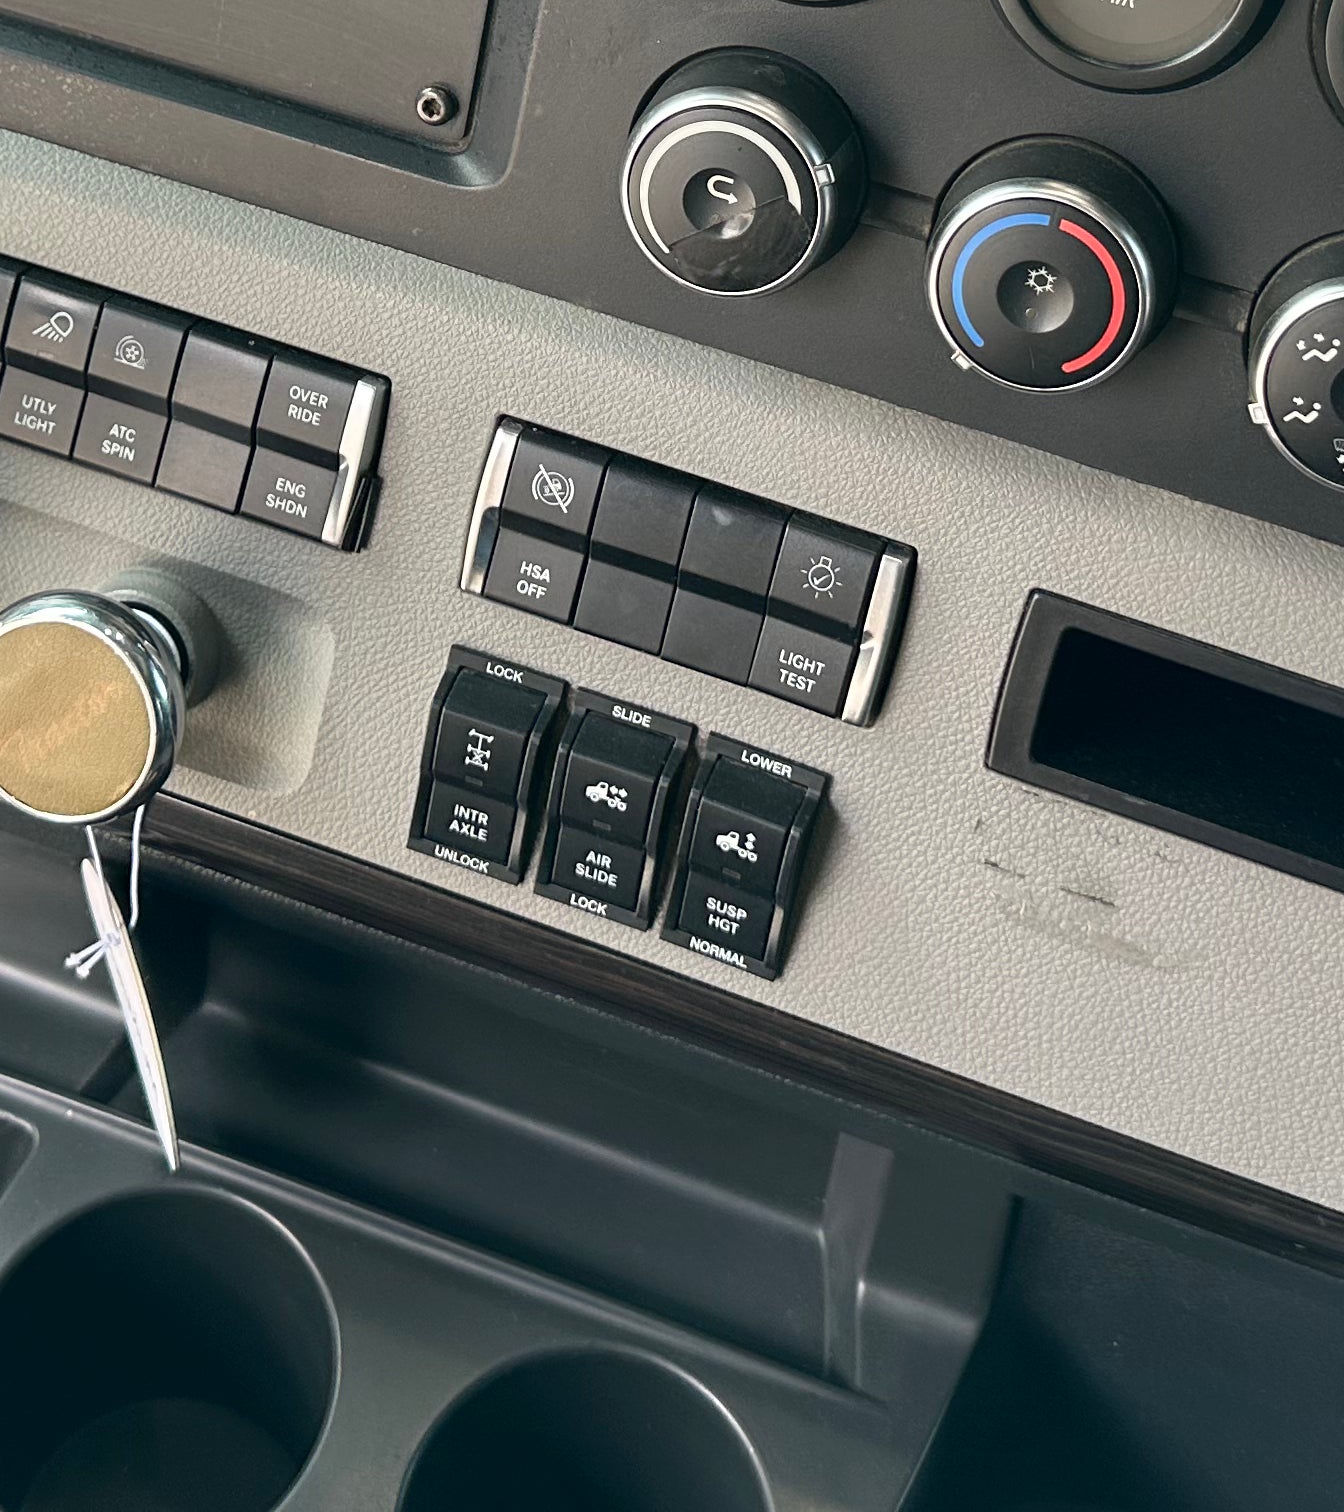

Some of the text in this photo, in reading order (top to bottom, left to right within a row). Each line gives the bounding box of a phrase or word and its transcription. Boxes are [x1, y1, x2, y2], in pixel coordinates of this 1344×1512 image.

[22, 394, 57, 415] UTLY
[289, 385, 329, 409] OVER
[14, 414, 56, 435] LIGHT
[287, 404, 321, 427] RIDE
[109, 423, 136, 443] ATC
[101, 440, 136, 463] SPIN
[275, 477, 306, 498] ENG
[265, 493, 308, 519] SHDN
[520, 560, 551, 584] HSA
[516, 579, 548, 600] OFF
[485, 661, 524, 684] LOCK
[778, 649, 826, 677] LIGHT
[779, 669, 816, 694] TEST
[612, 704, 652, 728] SLIDE
[740, 749, 793, 779] LOWER
[453, 803, 489, 827] INTR
[448, 819, 489, 843] AXLE
[433, 844, 490, 874] UNLOCK
[586, 850, 612, 870] AIR
[575, 863, 619, 888] SLIDE
[570, 893, 608, 917] LOCK
[706, 897, 748, 922] SUSP
[708, 915, 740, 936] HGT
[689, 936, 748, 969] NORMAL
